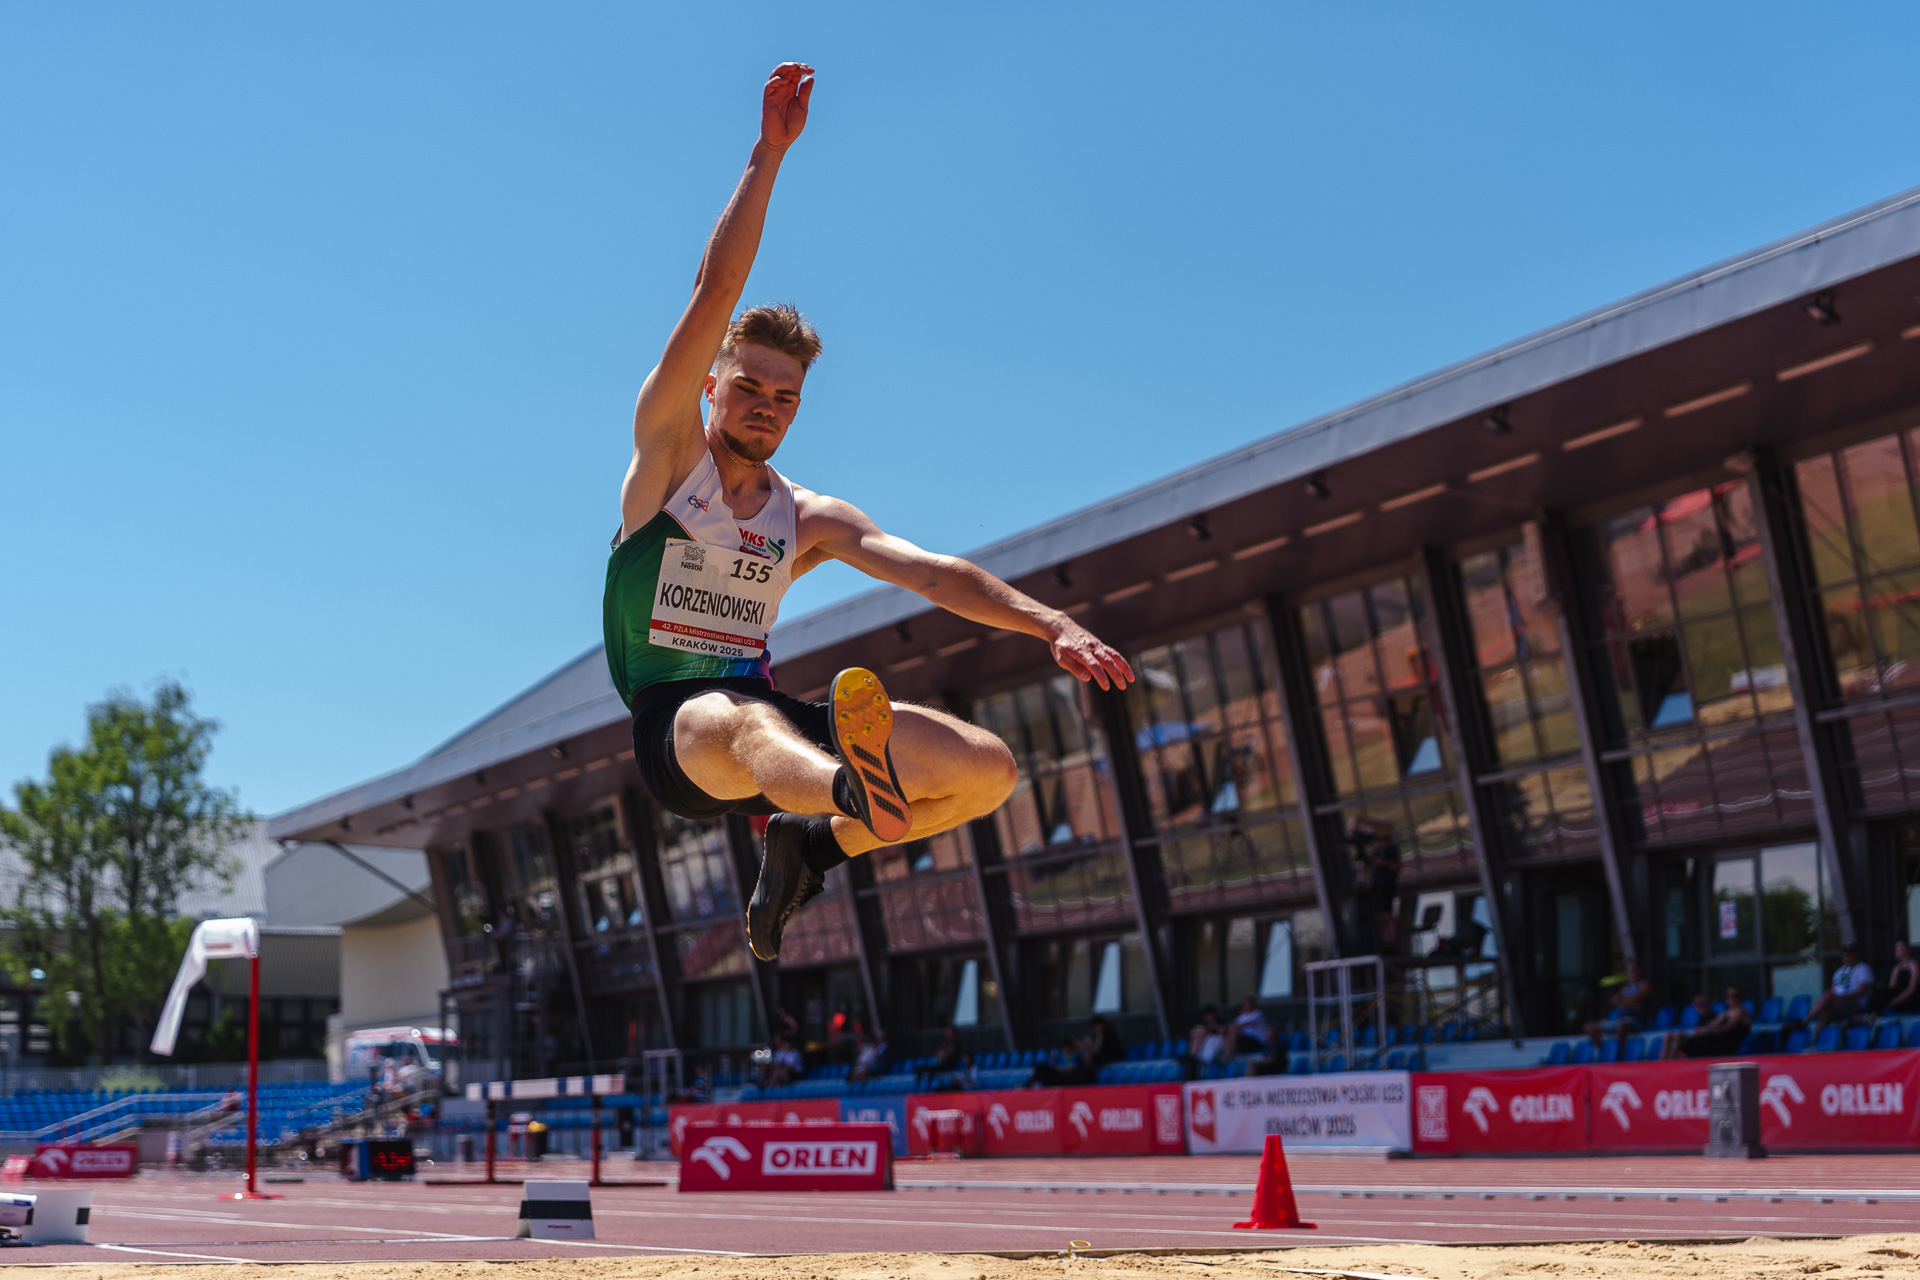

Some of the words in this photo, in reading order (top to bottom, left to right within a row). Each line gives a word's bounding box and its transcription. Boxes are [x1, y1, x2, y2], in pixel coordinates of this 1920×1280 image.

[739, 528, 765, 547] MKS
[730, 558, 773, 583] 155
[659, 582, 766, 625] KORZENIOWSKI
[662, 623, 672, 631] 42.
[673, 625, 688, 633] PZLA
[689, 628, 725, 640] Mistrzostwa
[725, 635, 743, 644] Polski
[672, 637, 718, 653] KRAKÓW
[719, 646, 744, 657] 2025
[1510, 1093, 1574, 1123] ORLEN
[1654, 1089, 1710, 1120] ORLE
[1820, 1082, 1905, 1116] ORLEN
[1014, 1110, 1055, 1132] ORLEN
[1100, 1107, 1143, 1131] ORLEN
[771, 1148, 868, 1169] ORLEN
